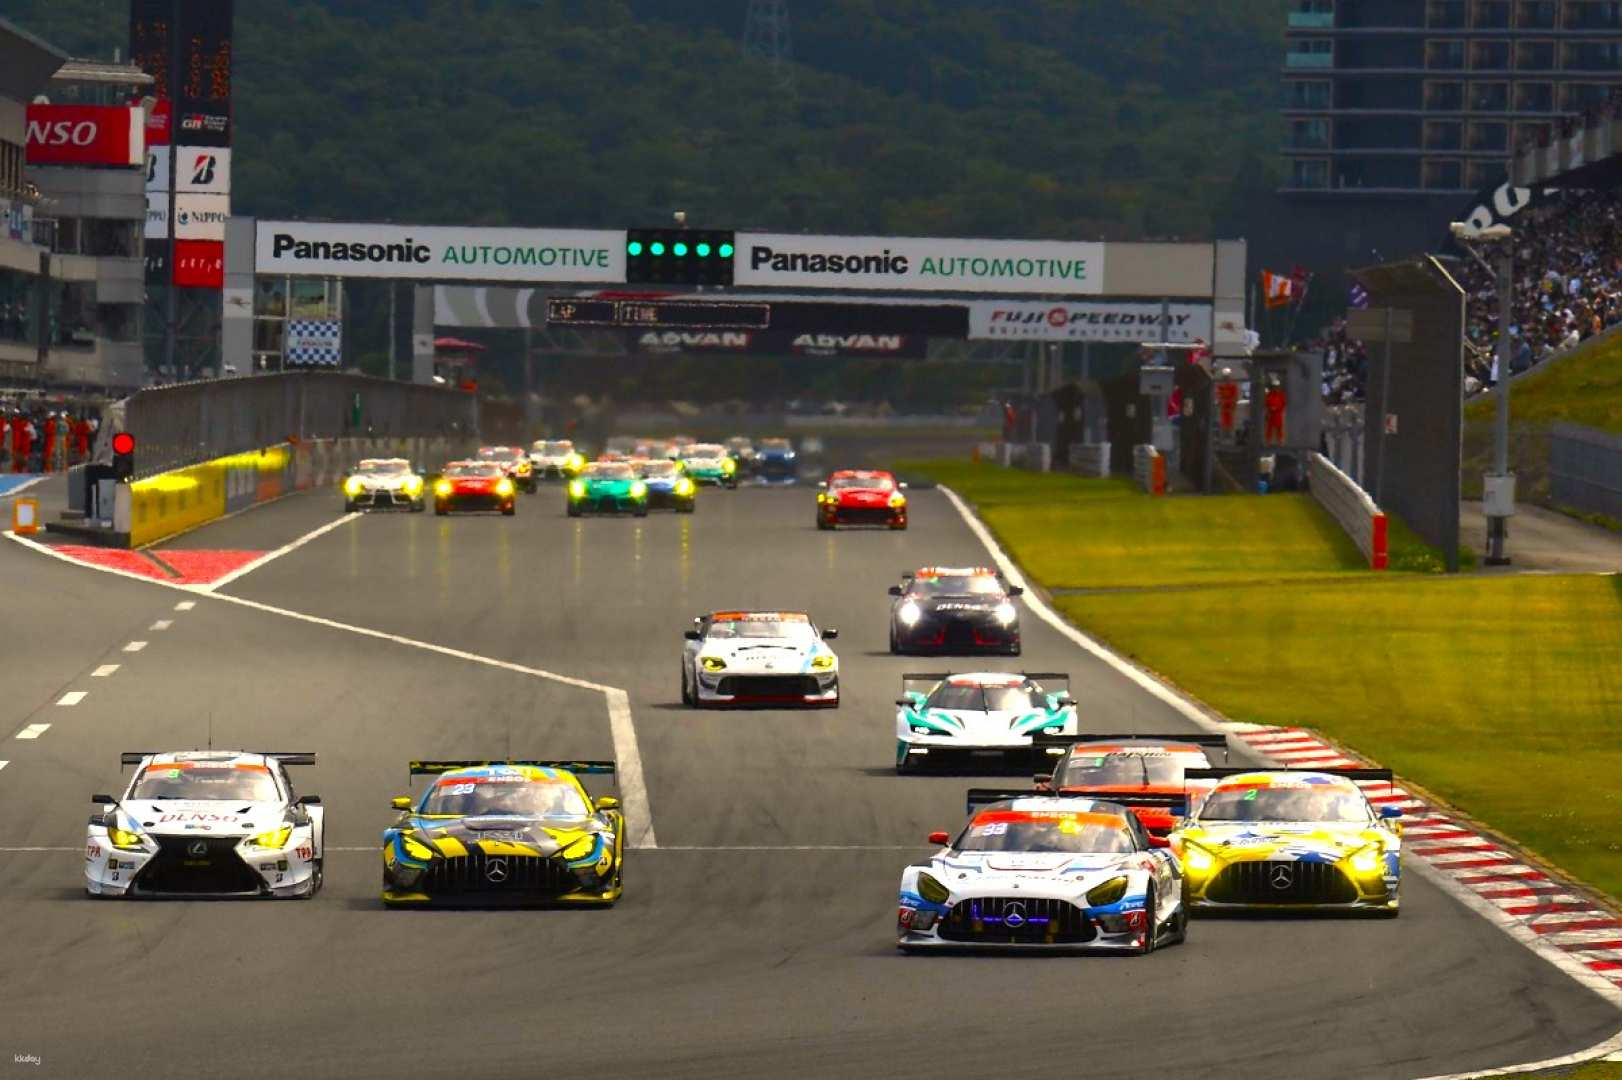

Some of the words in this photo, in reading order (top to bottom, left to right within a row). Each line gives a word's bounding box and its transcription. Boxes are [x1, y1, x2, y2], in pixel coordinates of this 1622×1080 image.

[272, 233, 431, 264] Panasonic
[442, 245, 609, 268] AUTOMOTIVE
[751, 246, 909, 275] Panasonic
[919, 256, 1087, 280] AUTOMOTIVE
[639, 331, 748, 350] ADVAN
[791, 333, 901, 350] ADVAN
